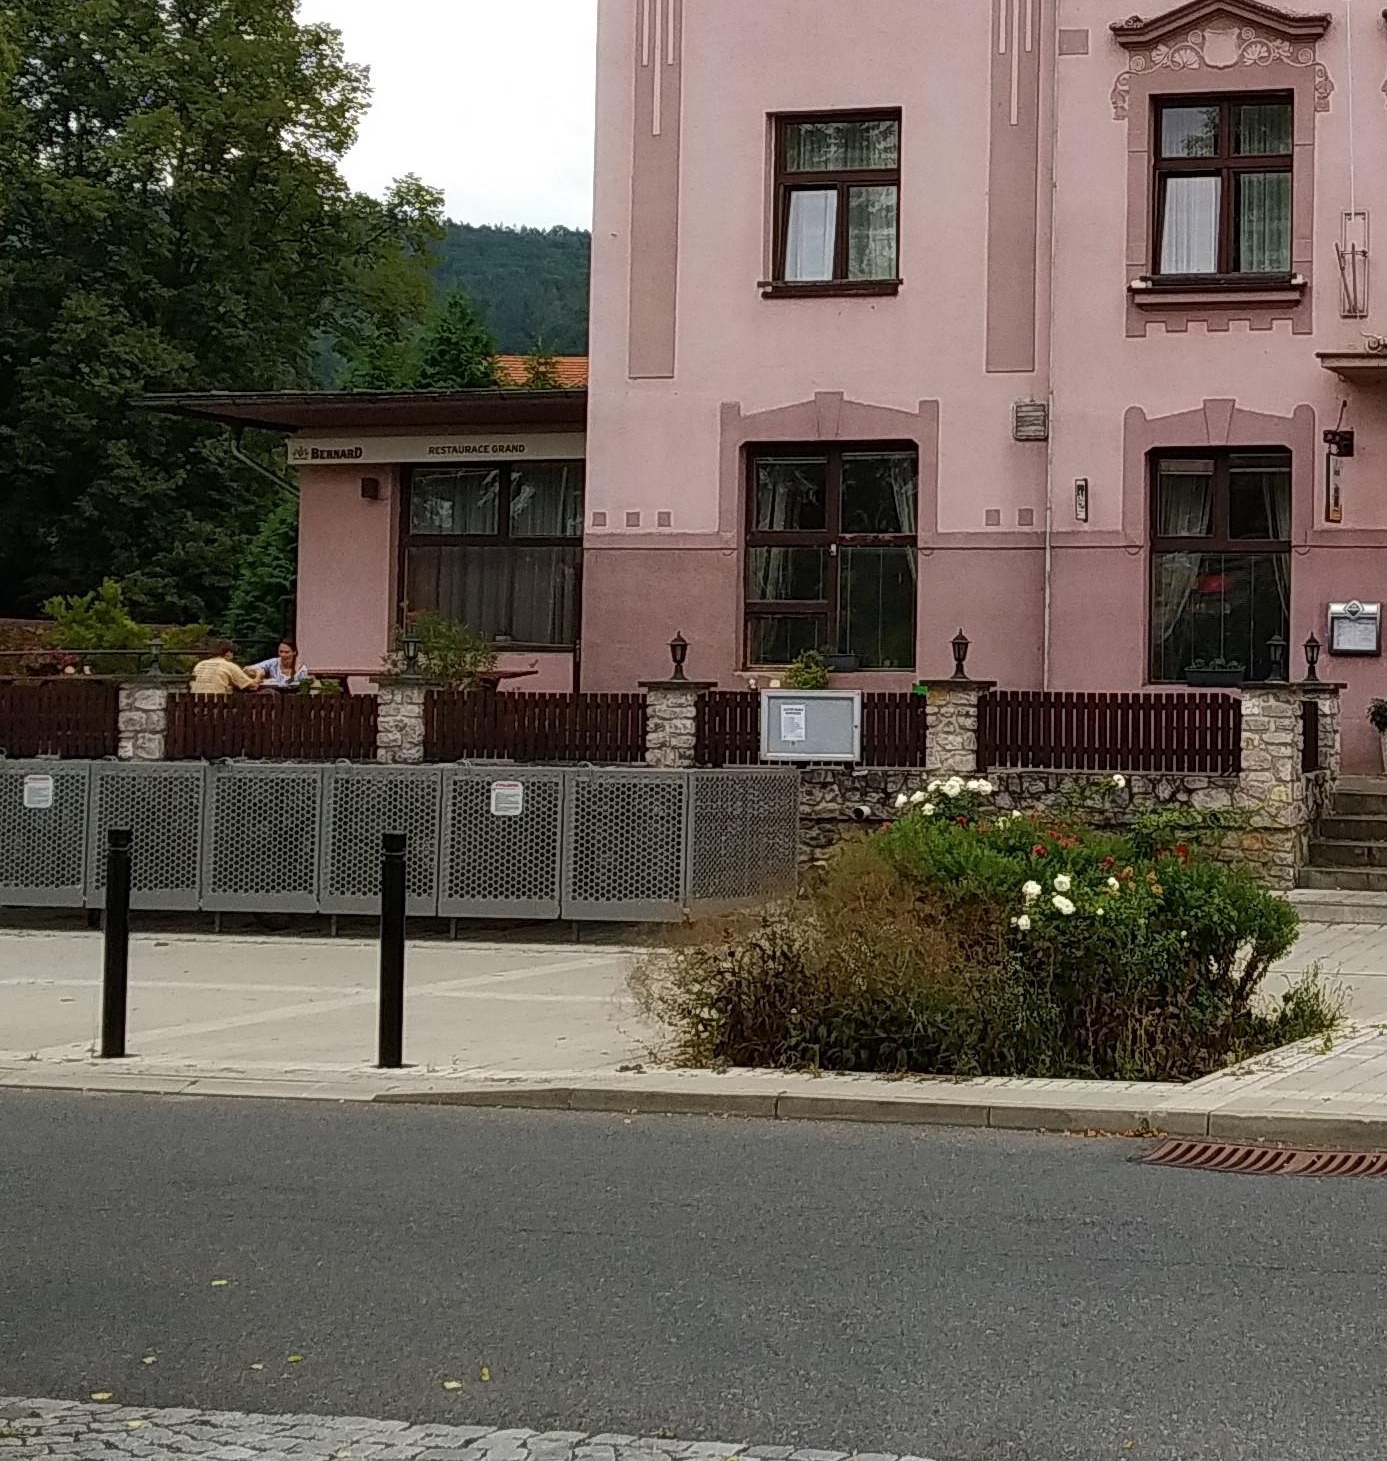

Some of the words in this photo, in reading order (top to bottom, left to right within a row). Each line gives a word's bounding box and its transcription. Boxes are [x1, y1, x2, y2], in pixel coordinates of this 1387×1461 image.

[310, 446, 363, 460] BERNARD
[428, 444, 490, 455] RESTAURACE
[491, 444, 525, 454] GRAND
